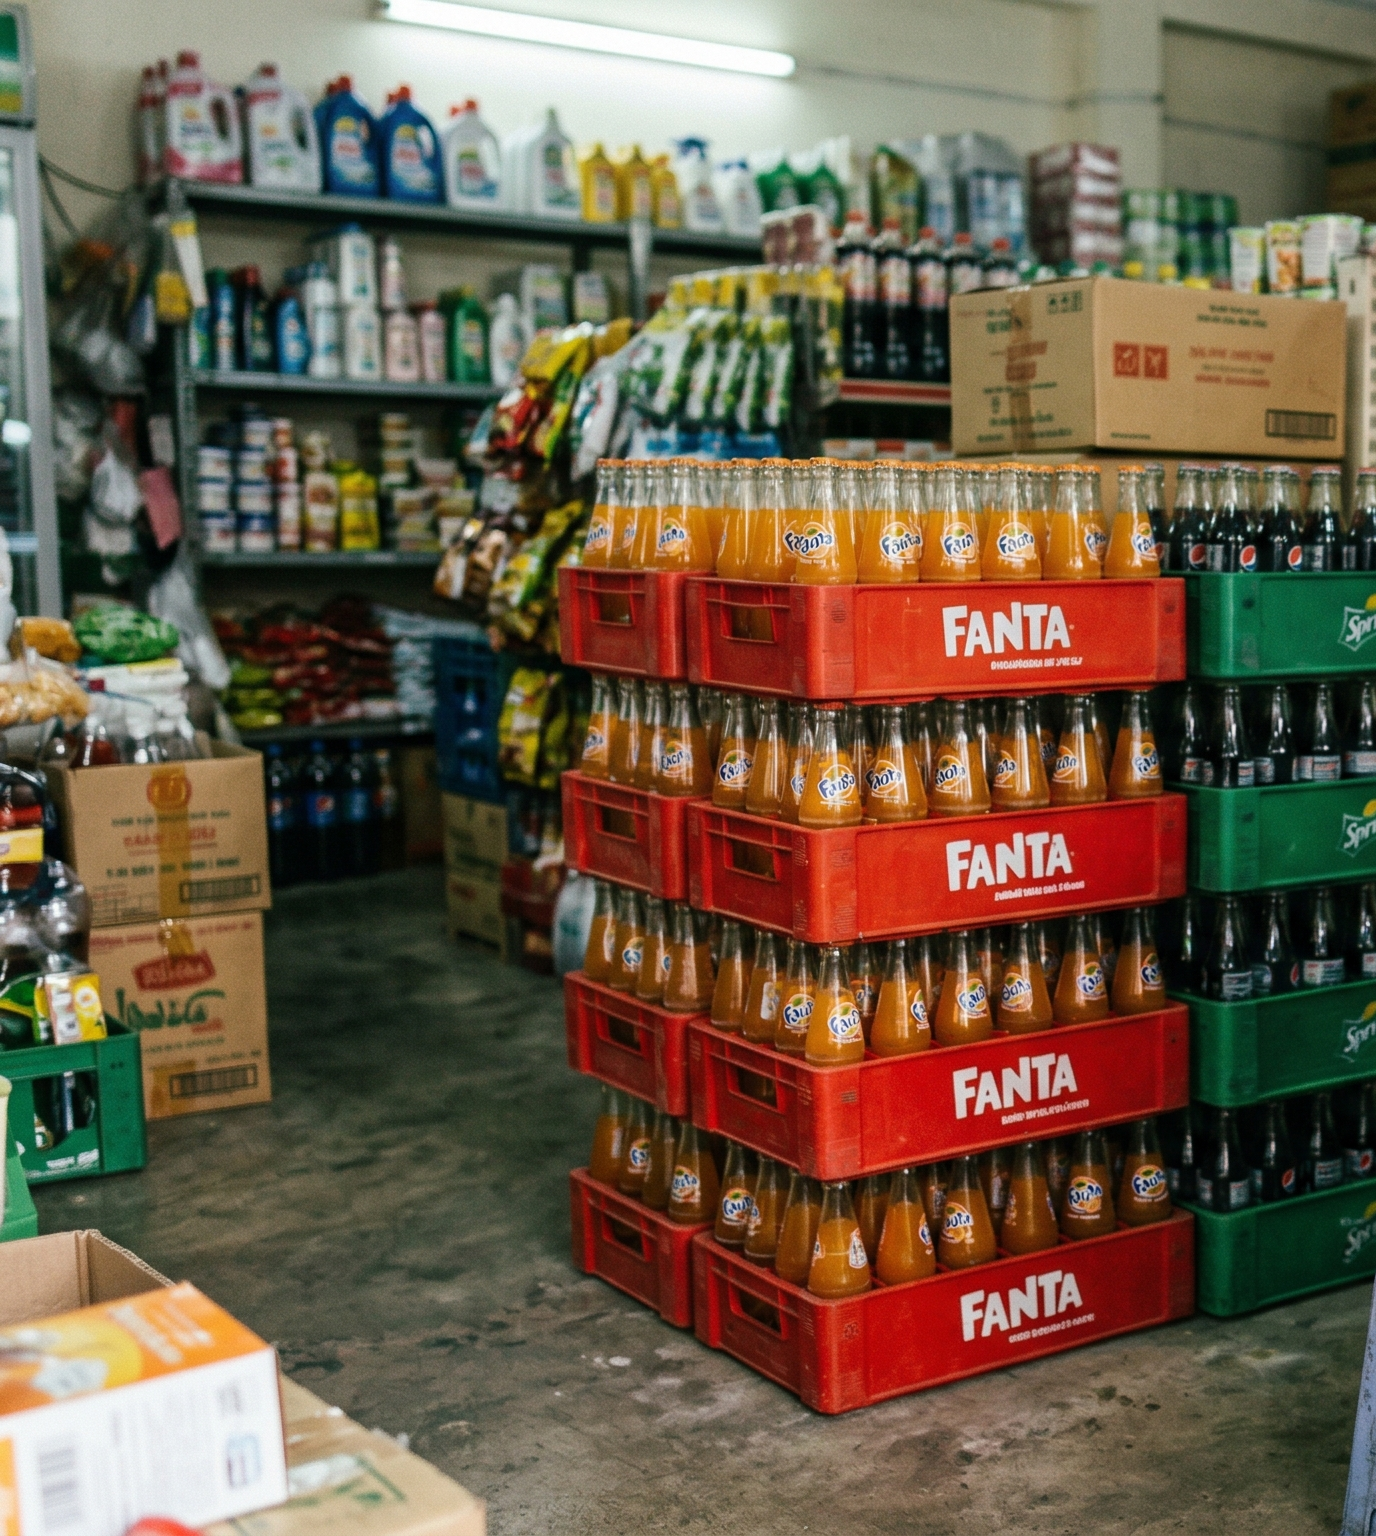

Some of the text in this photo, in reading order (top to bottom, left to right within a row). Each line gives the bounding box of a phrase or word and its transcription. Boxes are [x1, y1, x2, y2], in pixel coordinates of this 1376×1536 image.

[942, 602, 1071, 657] FANTA
[946, 832, 1073, 892] FANTA
[953, 1053, 1078, 1120] FANTA
[960, 1270, 1083, 1342] FANTA
